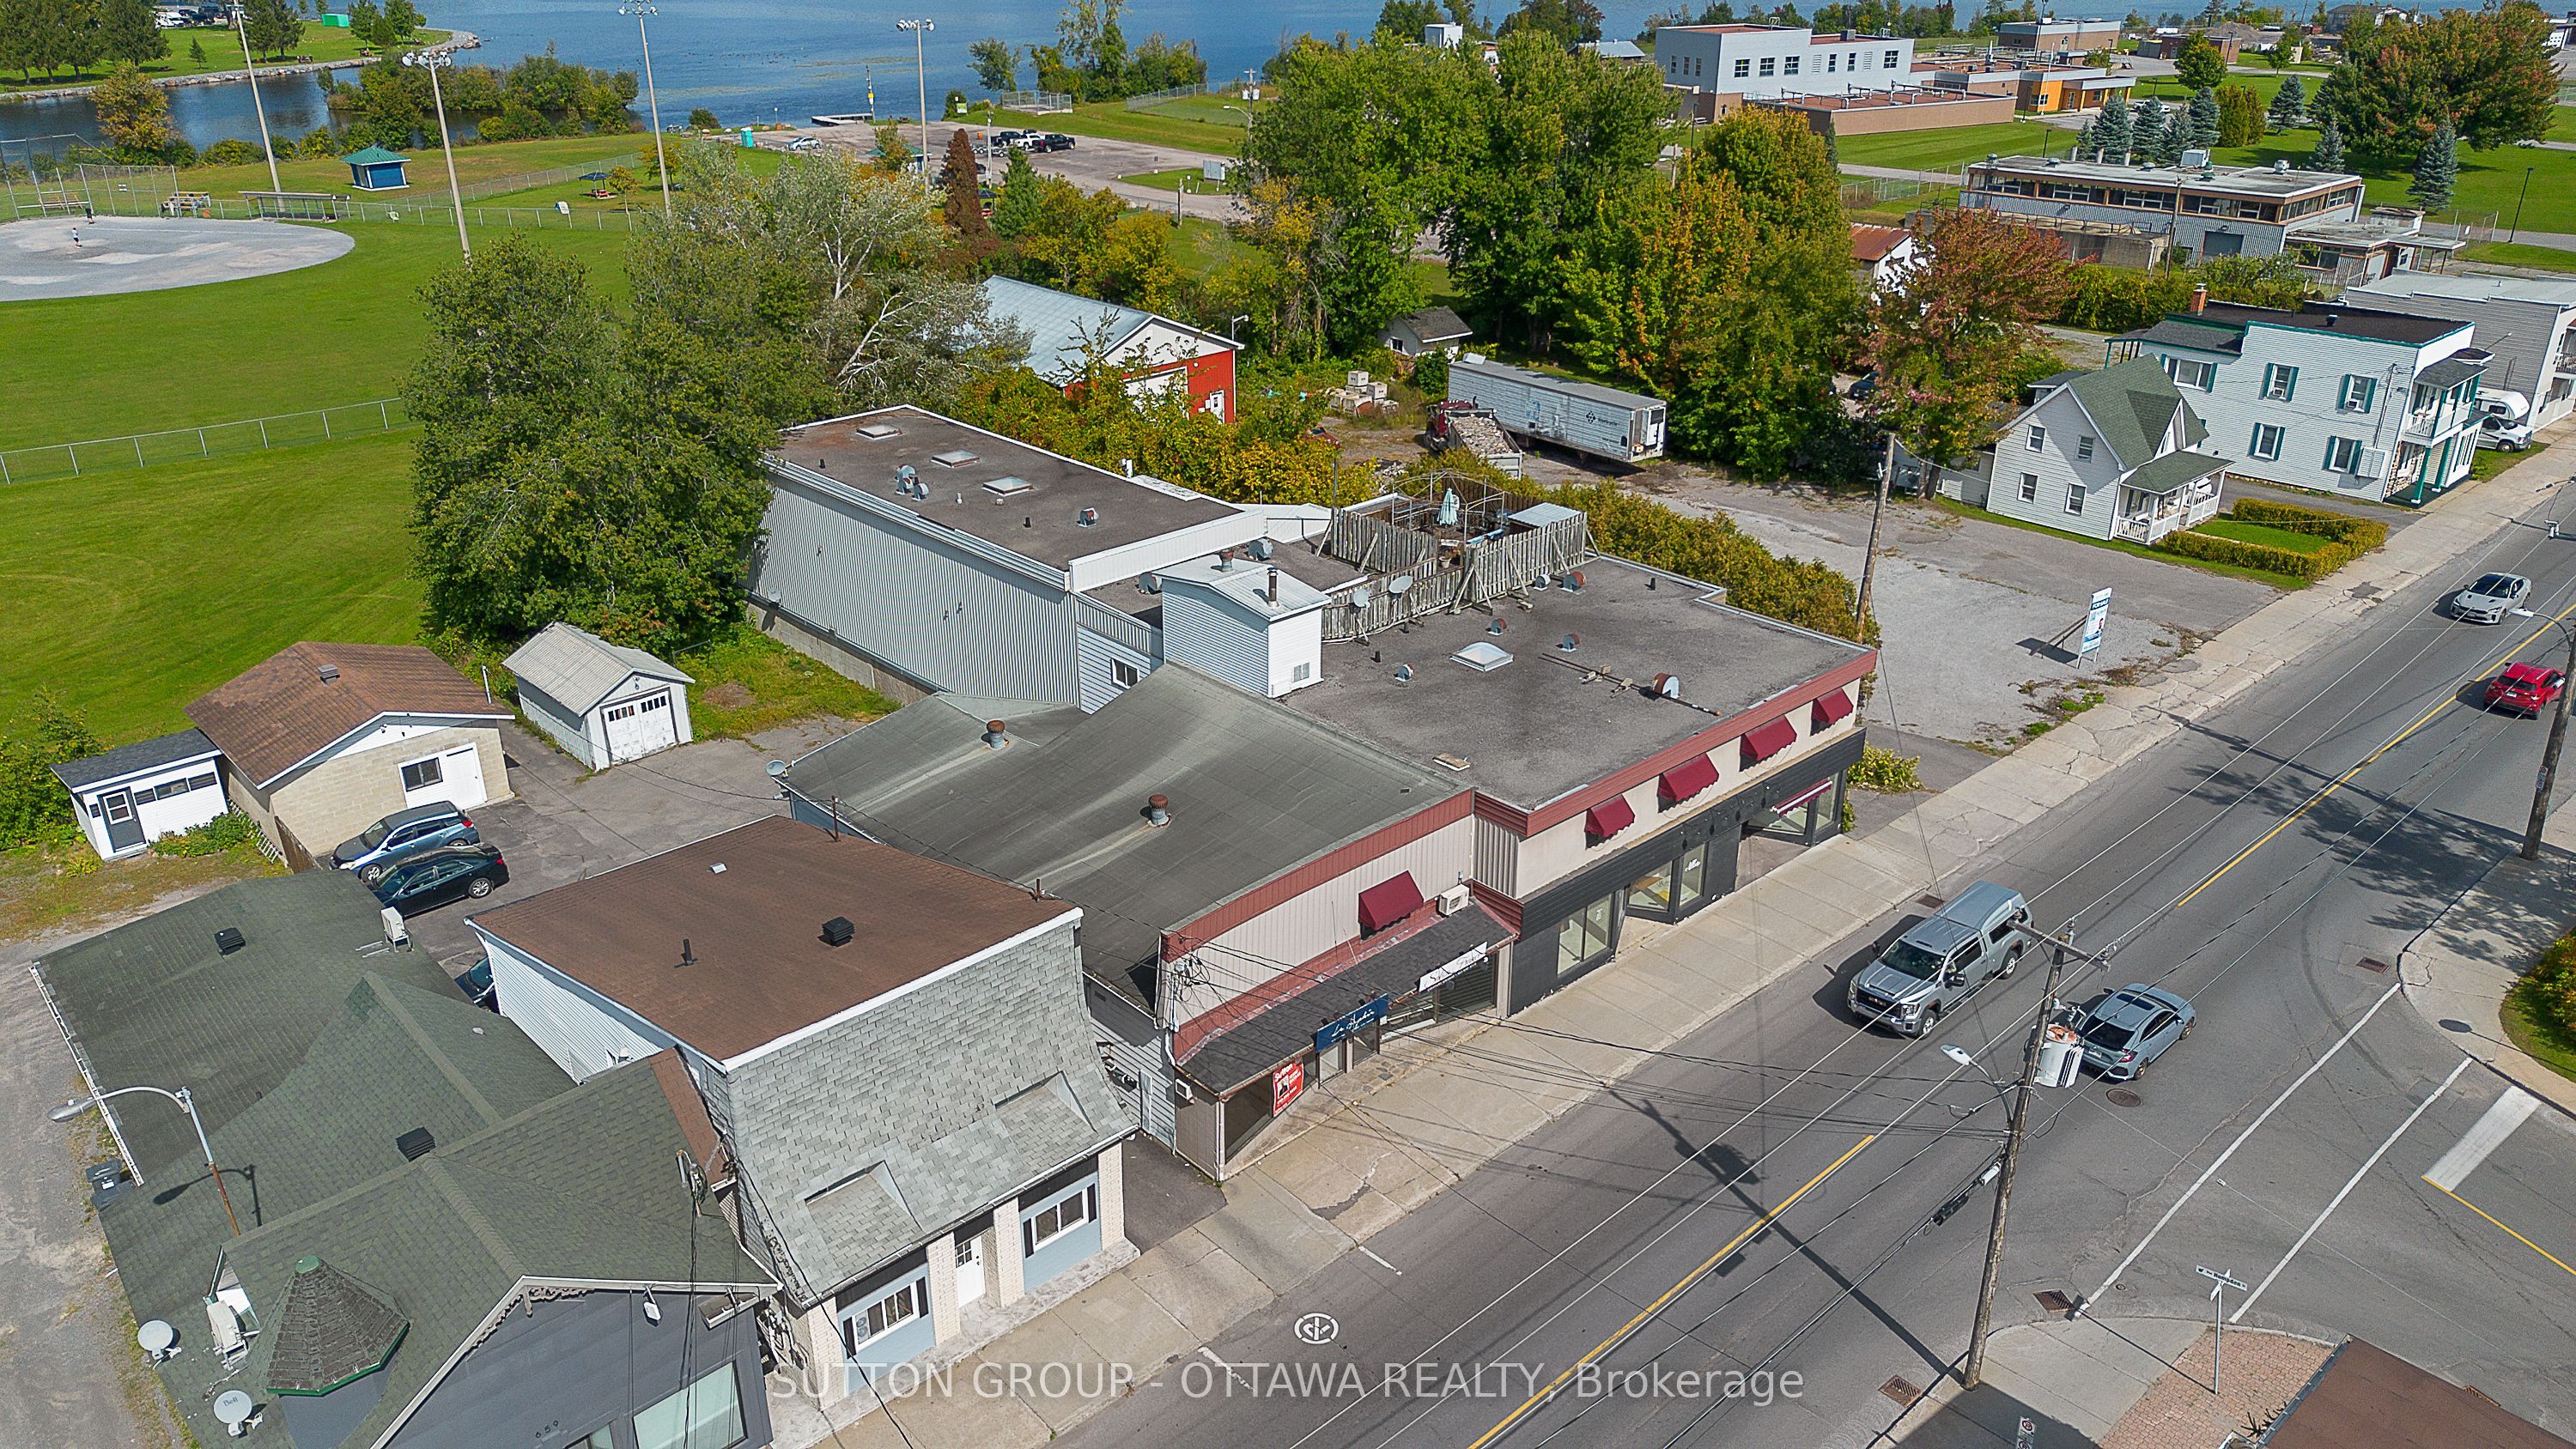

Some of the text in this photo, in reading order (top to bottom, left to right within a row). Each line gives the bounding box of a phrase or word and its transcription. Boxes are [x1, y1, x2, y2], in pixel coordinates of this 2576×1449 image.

[2214, 1273, 2241, 1287] Hampden
[222, 1396, 239, 1407] Bell
[535, 1420, 559, 1439] 659
